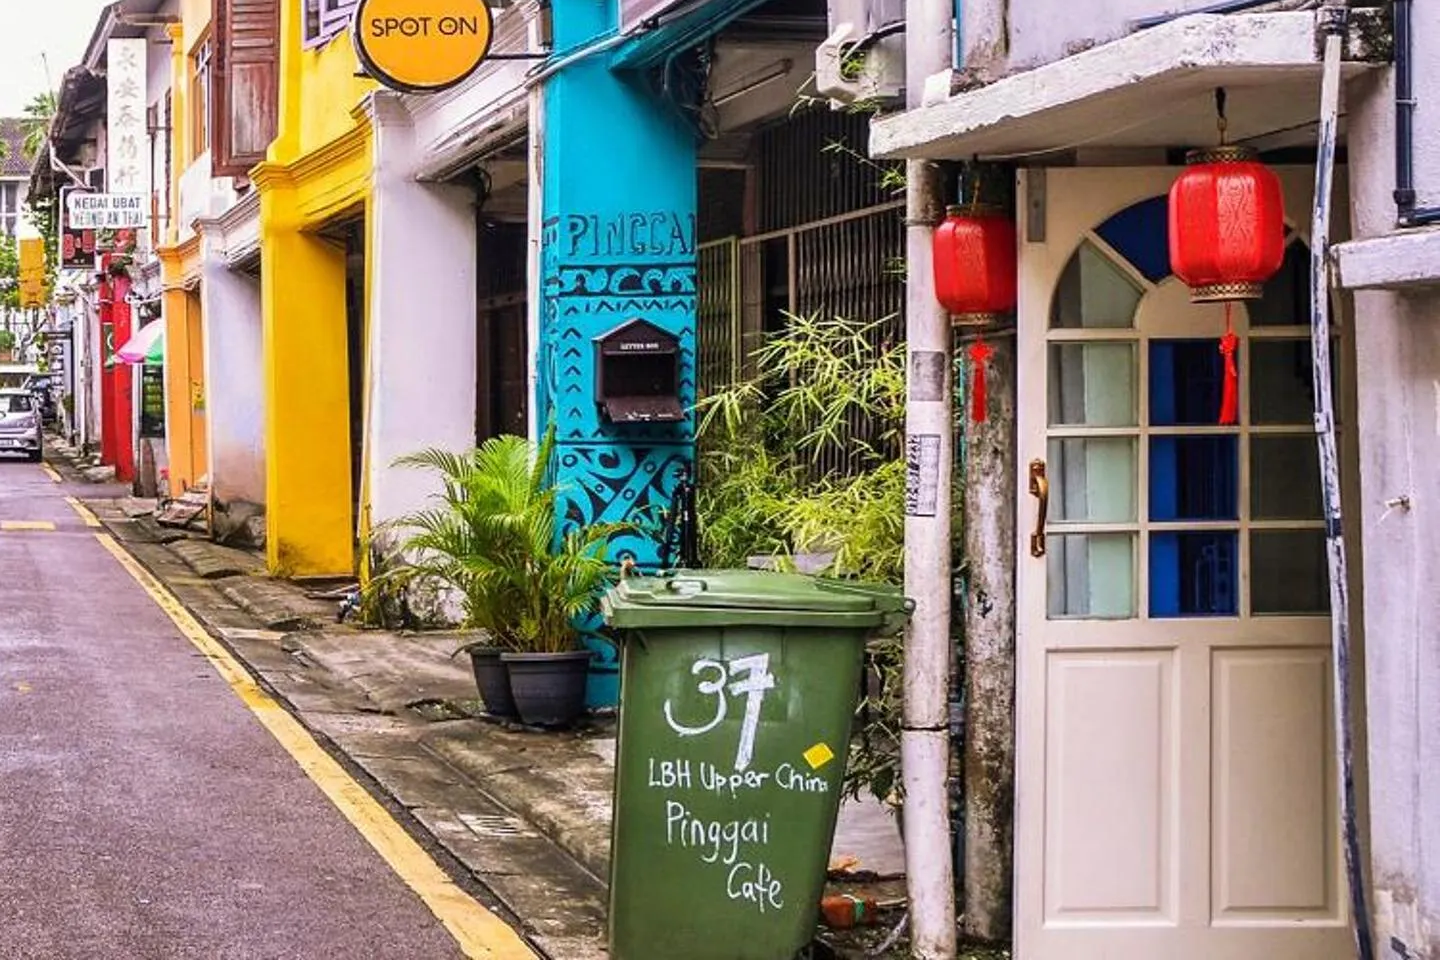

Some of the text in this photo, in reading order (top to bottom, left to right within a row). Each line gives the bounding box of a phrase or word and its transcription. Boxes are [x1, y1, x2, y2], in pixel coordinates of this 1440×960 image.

[371, 16, 478, 38] SPOT ON
[74, 197, 141, 209] KEDAI UBAT
[107, 211, 120, 225] AN
[663, 652, 775, 772] 37
[648, 758, 828, 799] LBH Upper China
[666, 800, 771, 864] Pinggai
[727, 863, 784, 912] Cafe
